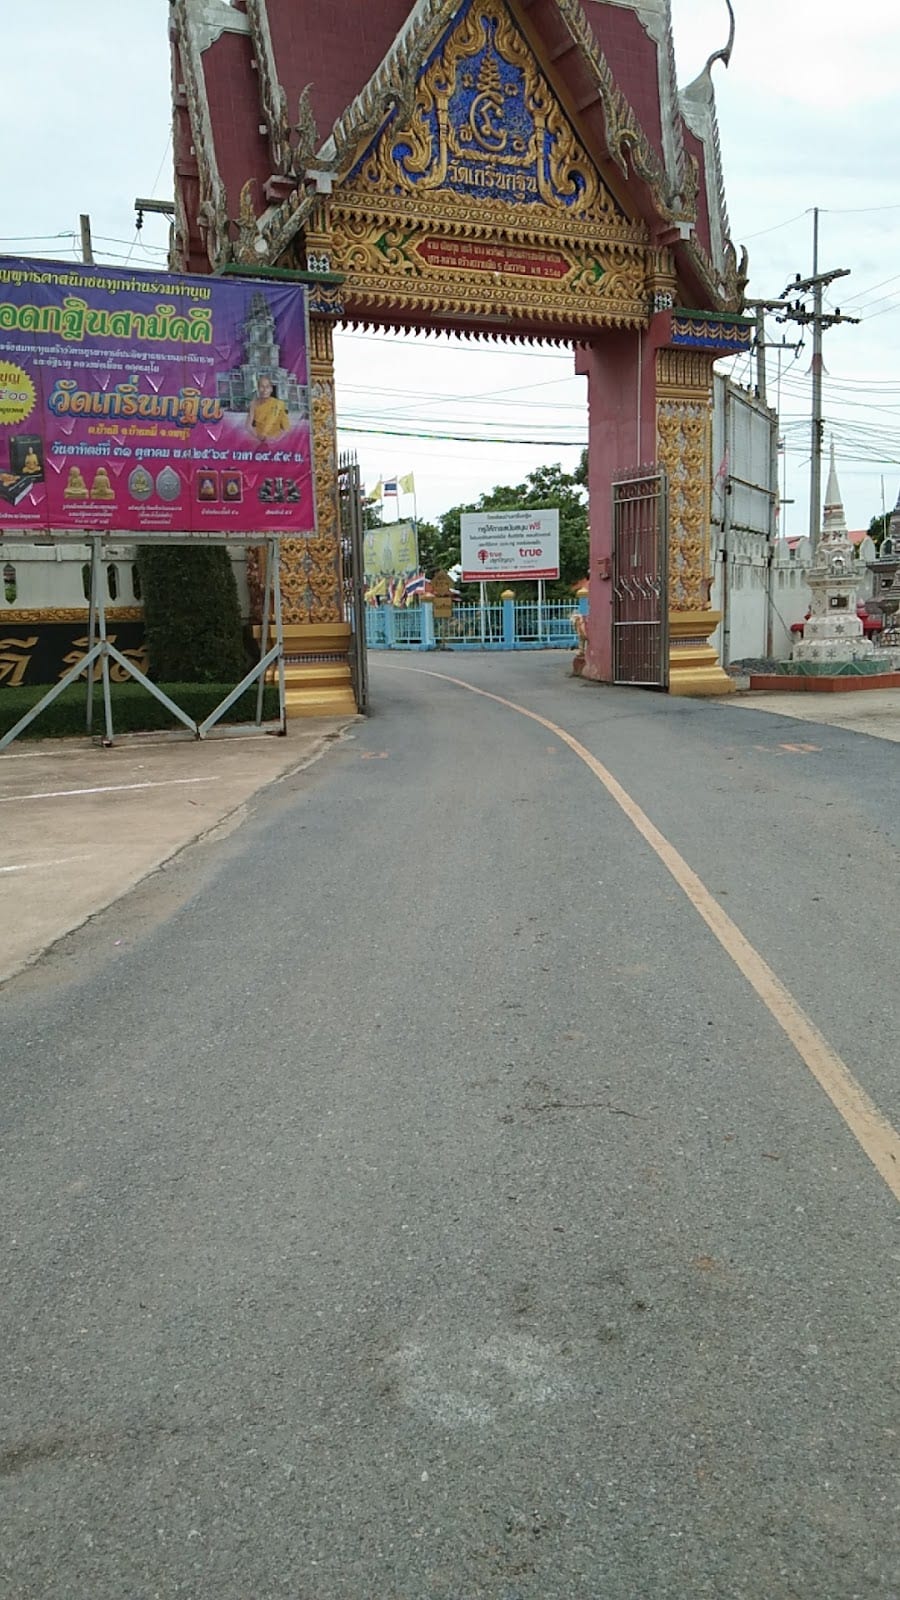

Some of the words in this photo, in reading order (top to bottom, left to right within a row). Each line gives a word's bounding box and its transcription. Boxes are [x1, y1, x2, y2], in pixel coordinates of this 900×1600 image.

[50, 374, 224, 427] วัดเกริ่นกฐิน
[52, 440, 111, 456] วันอาทิตย์ที่
[135, 448, 170, 460] ตุลาคม
[232, 451, 253, 461] เวลา
[519, 547, 543, 557] true
